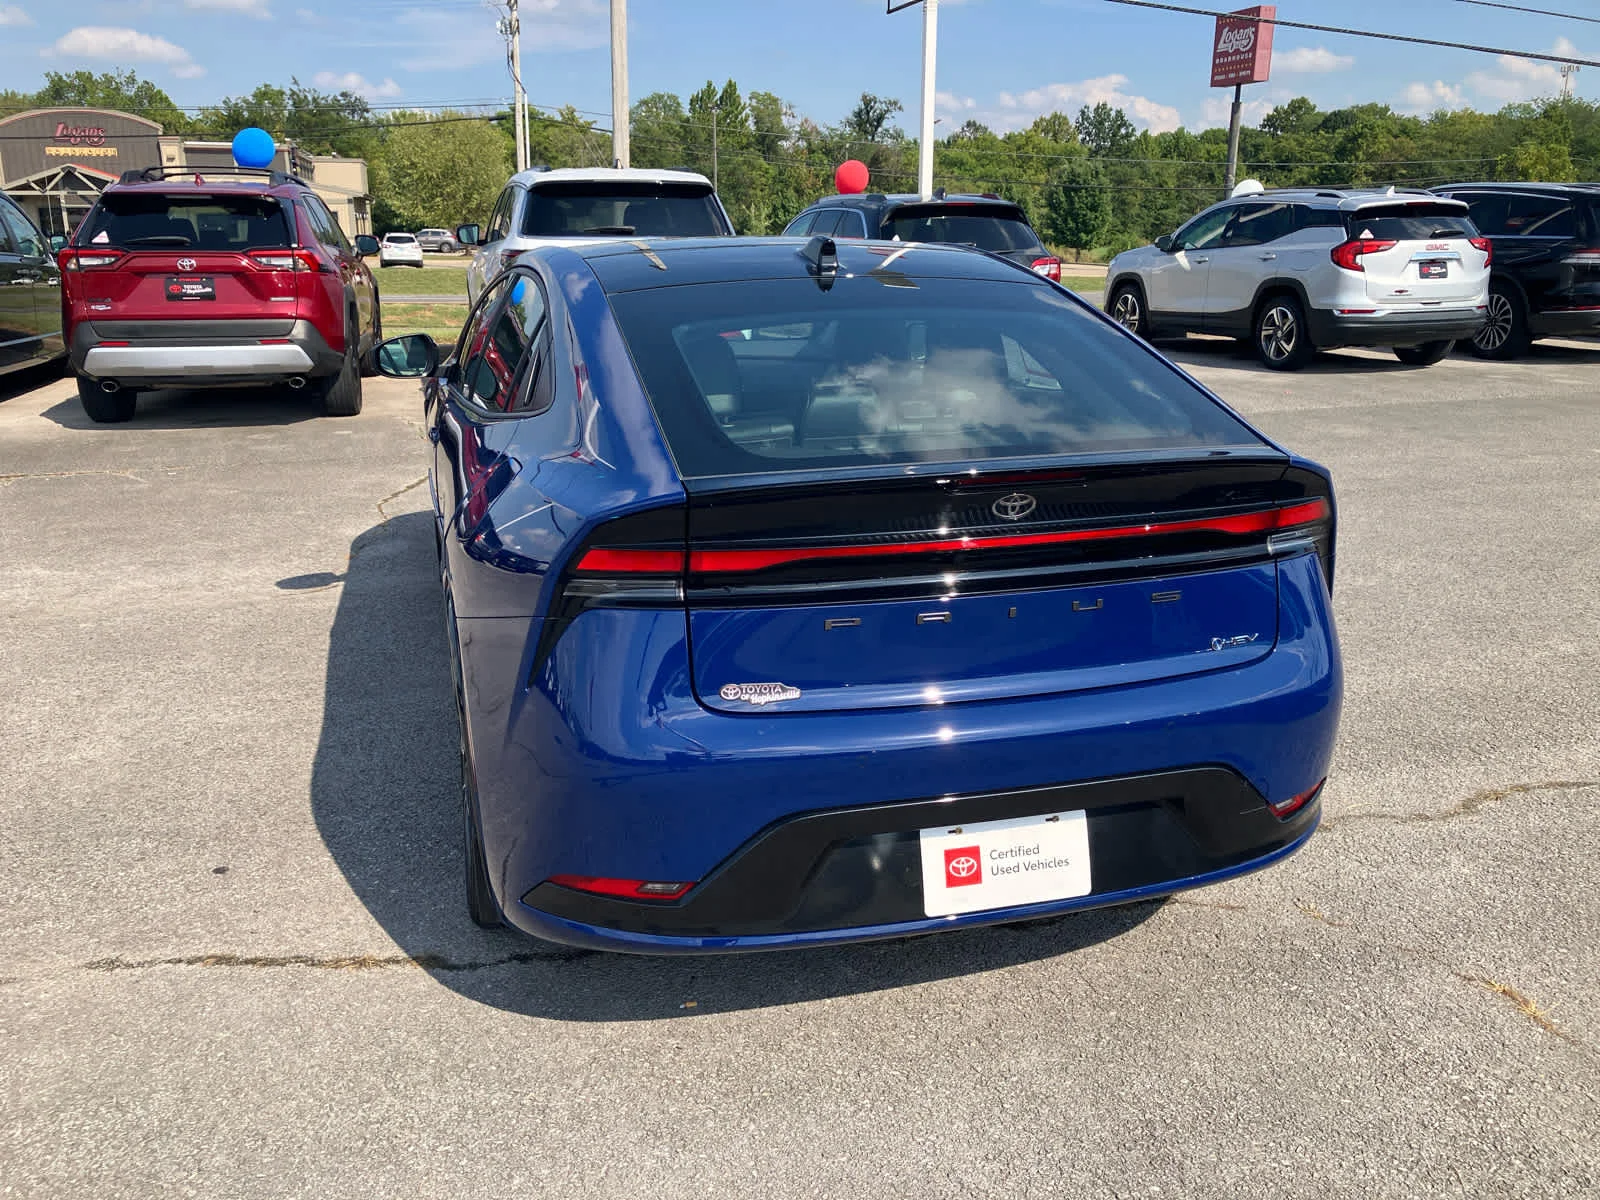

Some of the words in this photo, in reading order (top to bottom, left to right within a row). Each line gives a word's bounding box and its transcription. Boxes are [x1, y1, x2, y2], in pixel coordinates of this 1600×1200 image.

[824, 591, 1182, 631] PRIUS
[1222, 633, 1259, 646] HEV
[741, 684, 782, 694] TOYOTA
[989, 844, 1040, 860] Certified
[991, 862, 1020, 876] Used
[1023, 857, 1070, 872] Vehicles
